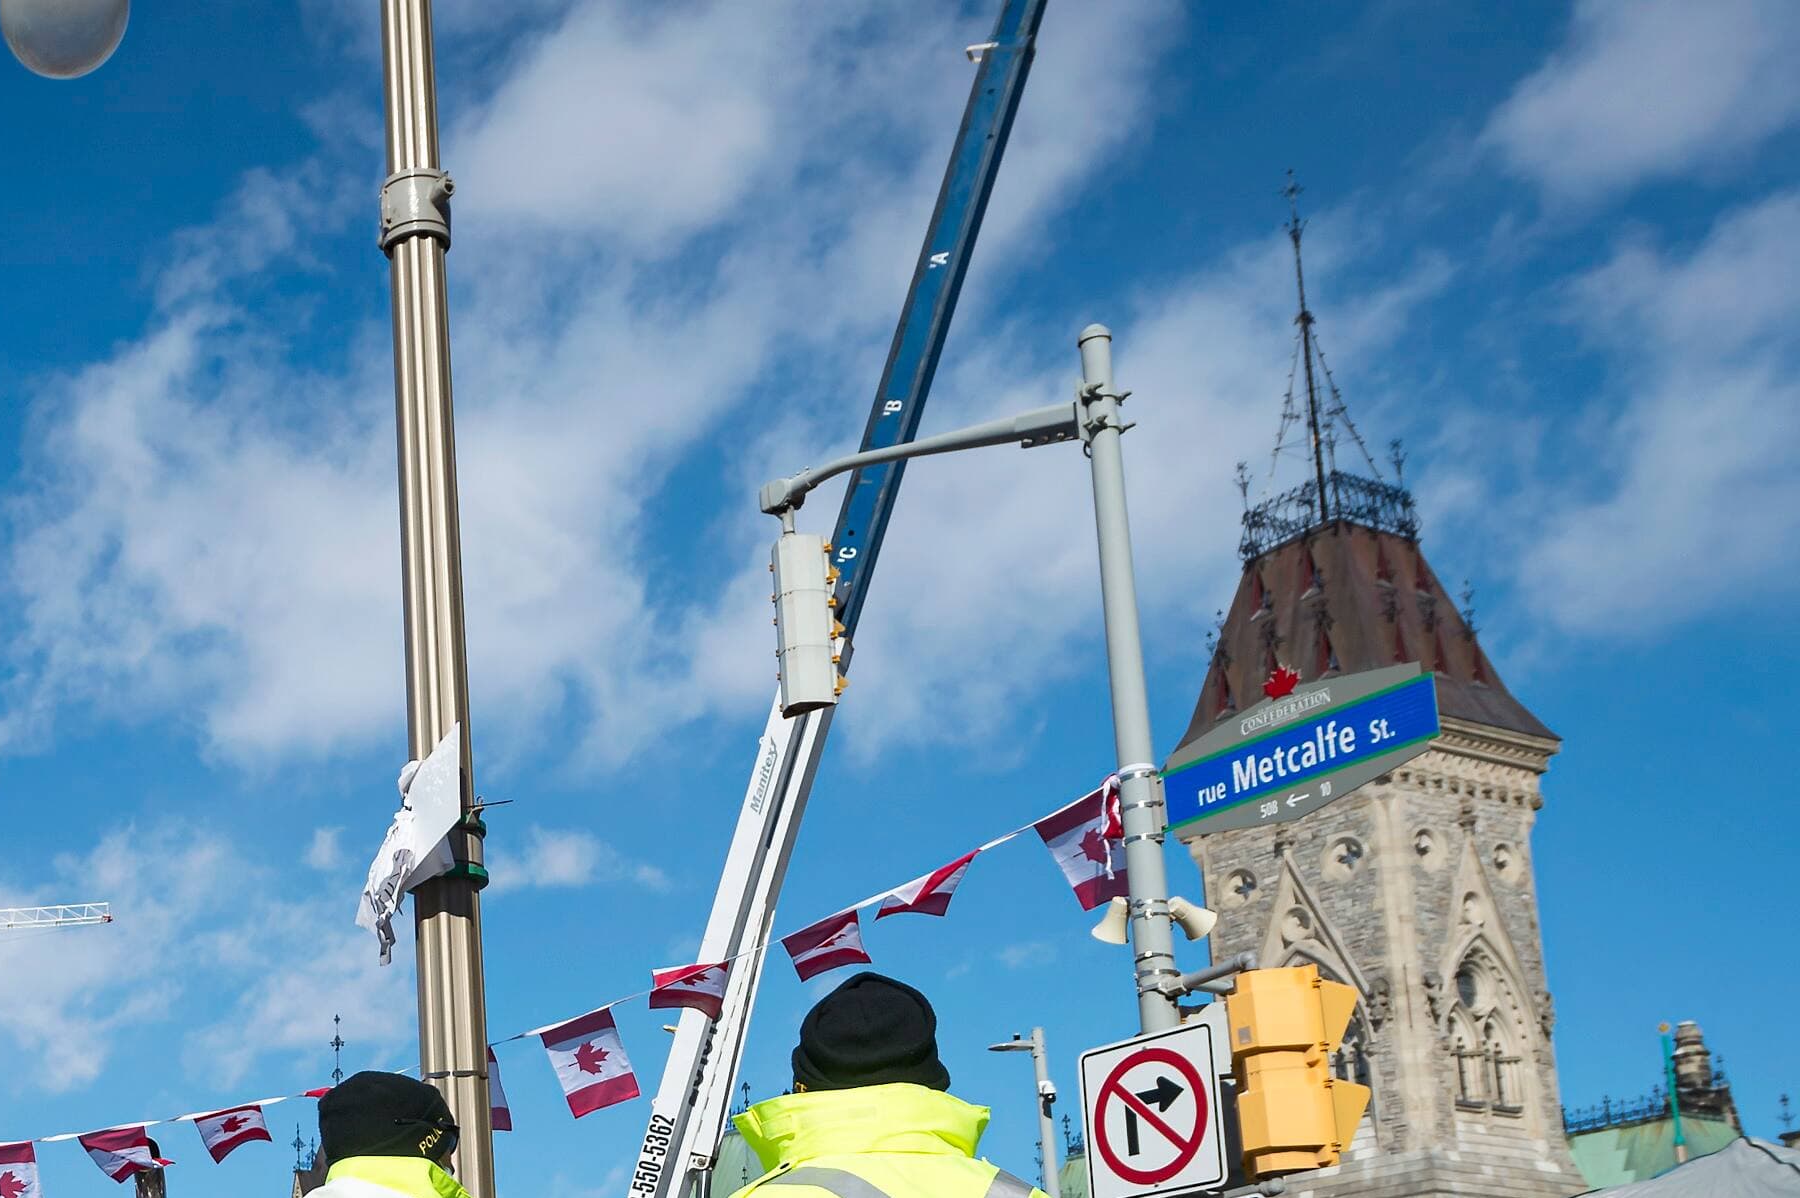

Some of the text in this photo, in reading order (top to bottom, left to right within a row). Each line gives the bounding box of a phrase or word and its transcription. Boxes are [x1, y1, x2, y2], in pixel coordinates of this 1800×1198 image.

[1240, 688, 1332, 736] CONFEDERATION
[750, 736, 778, 814] Manitex
[1198, 717, 1396, 806] rue Metcalfe St.
[1319, 781, 1333, 798] 10
